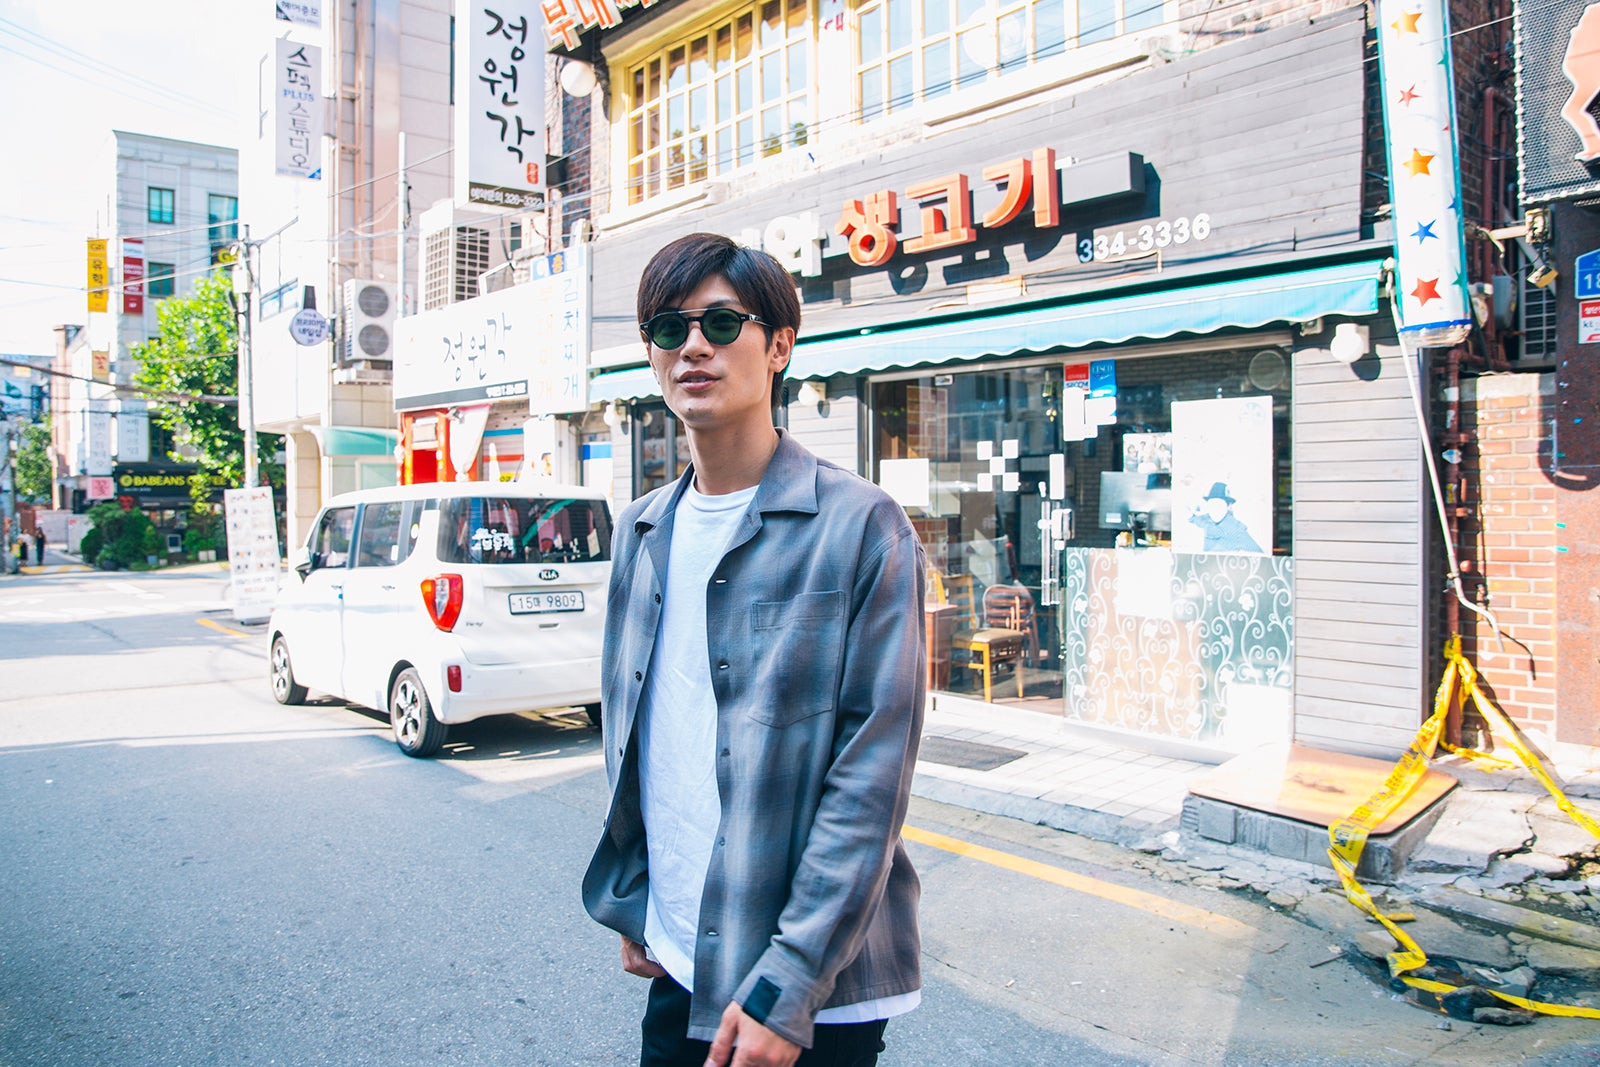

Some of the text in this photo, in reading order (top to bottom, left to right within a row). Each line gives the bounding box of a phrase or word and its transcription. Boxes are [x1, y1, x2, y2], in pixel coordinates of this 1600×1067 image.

[283, 88, 315, 102] PLUS
[478, 8, 536, 164] 정원각
[288, 102, 311, 170] 스튜디오
[835, 147, 1059, 266] 생고기
[1079, 213, 1210, 263] 334-3336
[443, 312, 512, 382] 정원각
[133, 475, 185, 487] BABEANS
[541, 570, 557, 581] KIA
[547, 595, 576, 608] 9809
